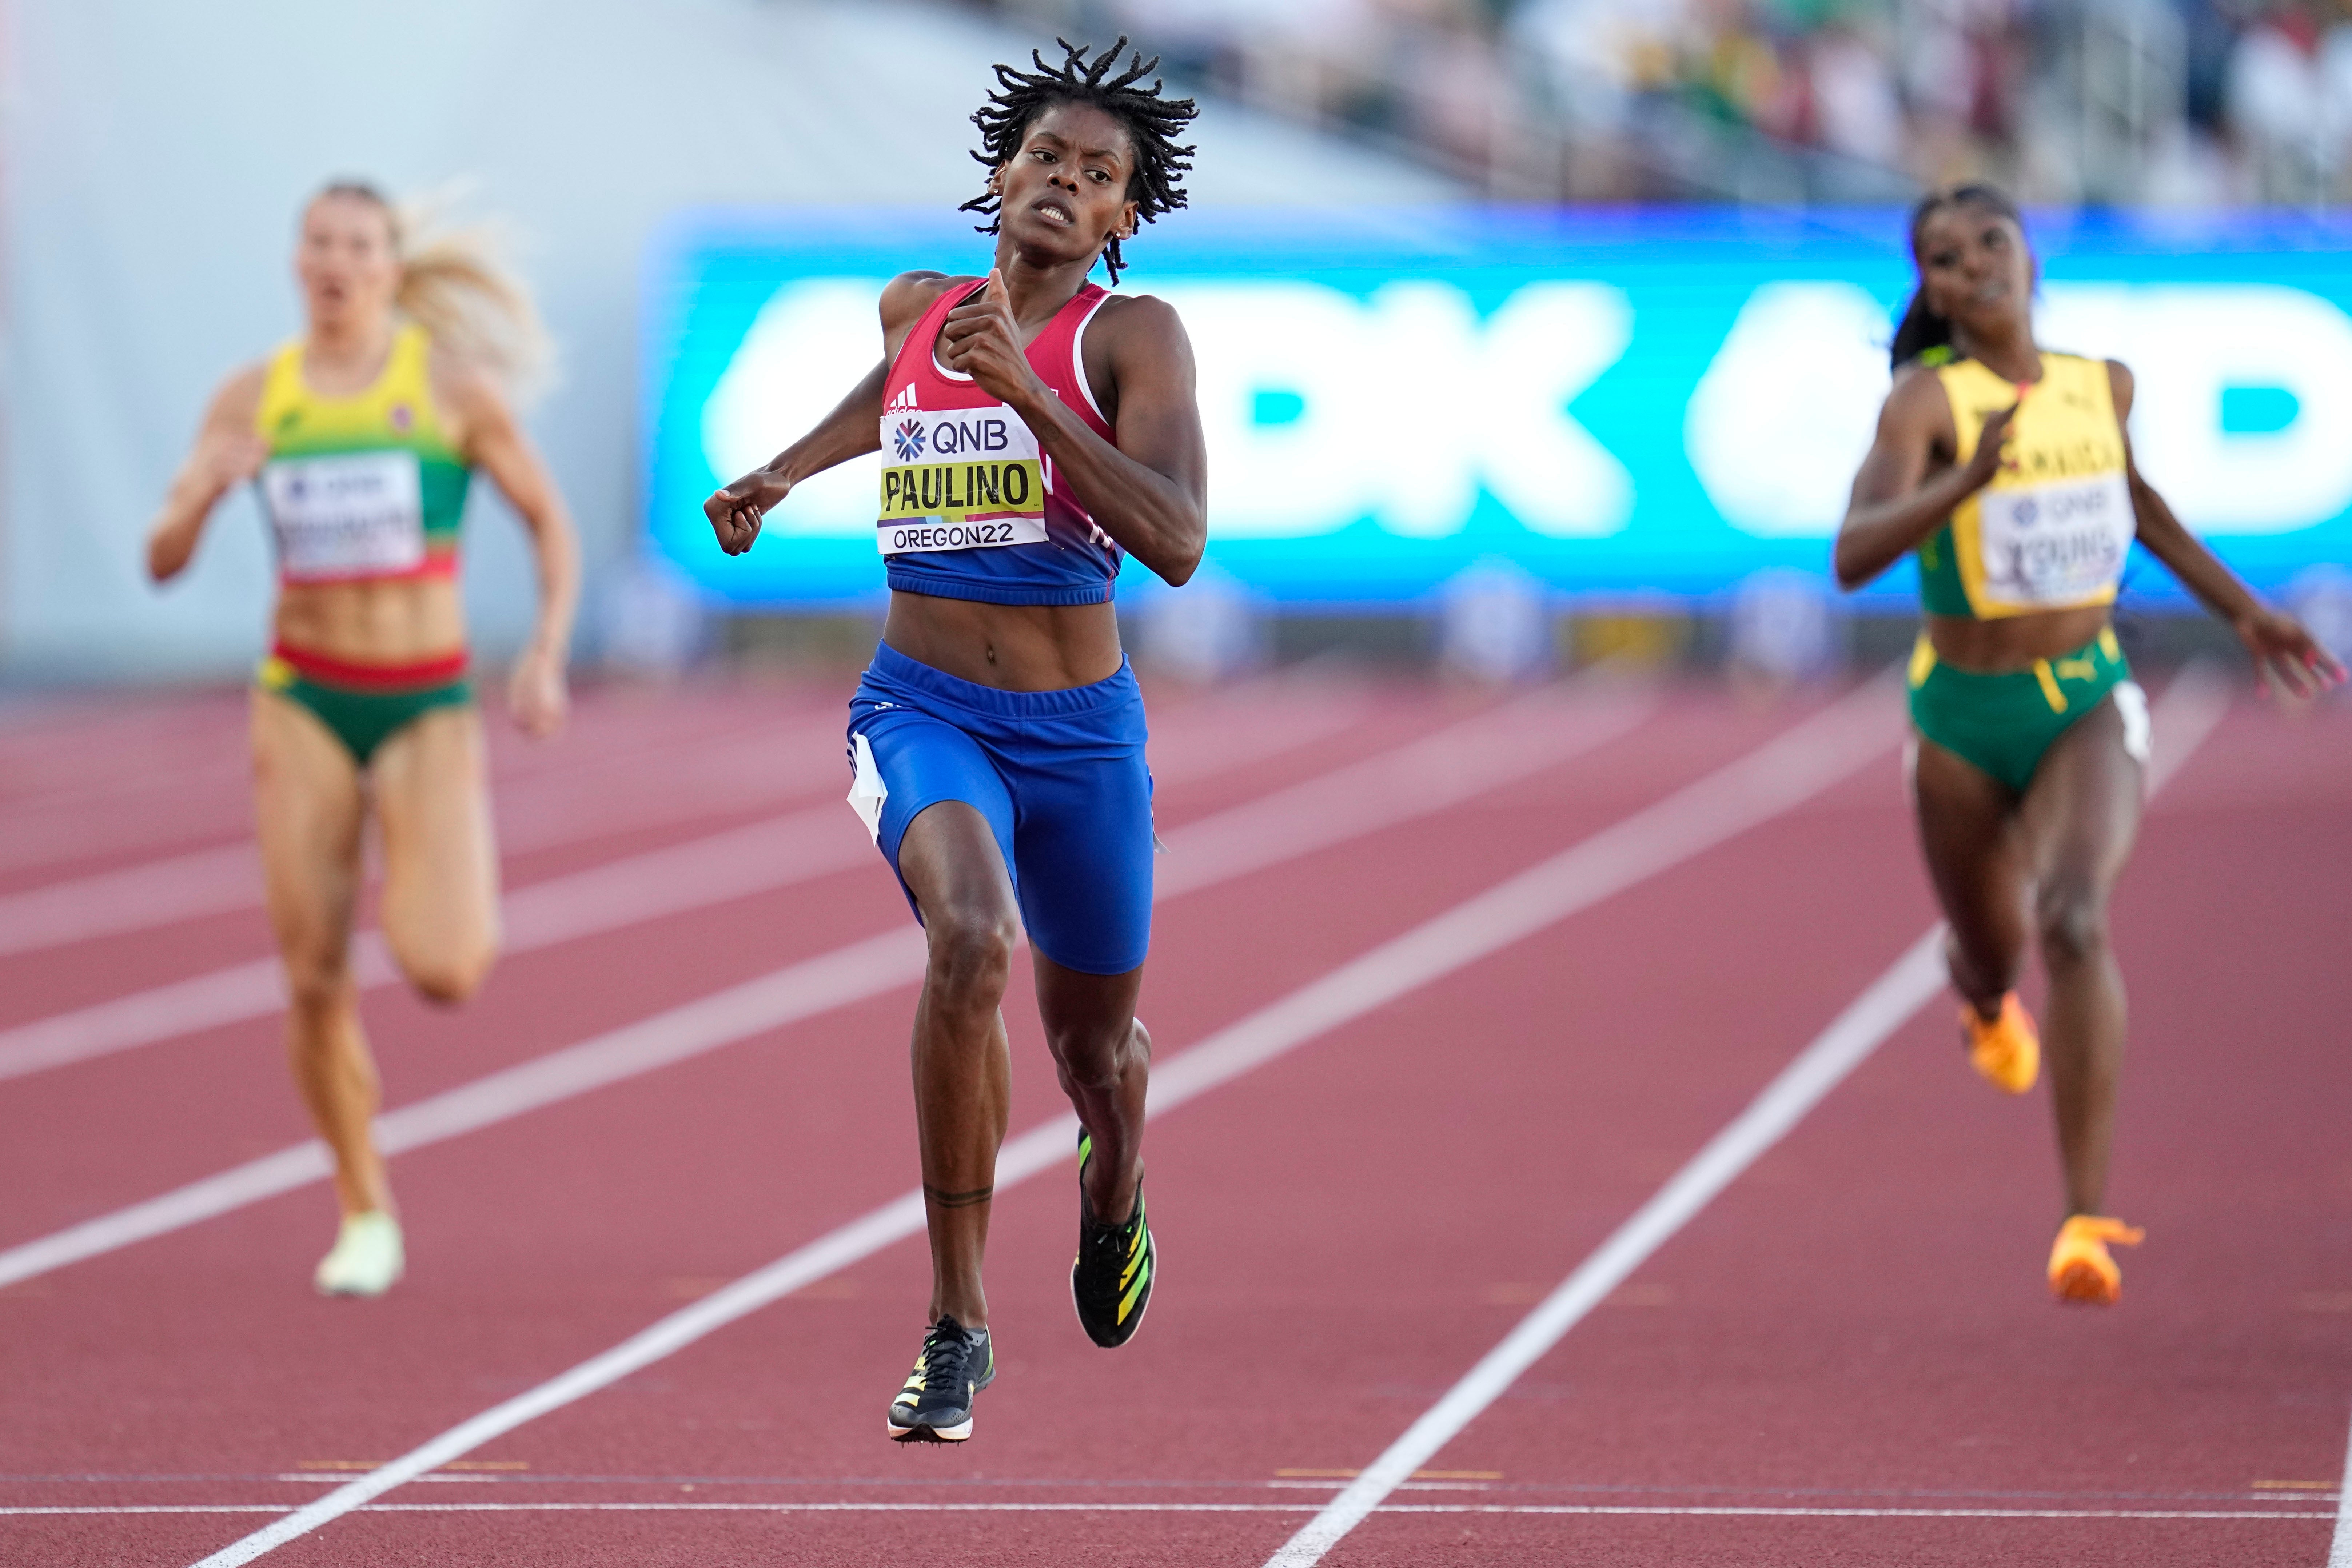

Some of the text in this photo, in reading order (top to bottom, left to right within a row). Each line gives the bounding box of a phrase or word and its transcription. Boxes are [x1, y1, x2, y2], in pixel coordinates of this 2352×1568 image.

[932, 419, 1008, 454] QNB
[885, 463, 1029, 512] PAULINO
[894, 523, 1014, 549] OREGON22
